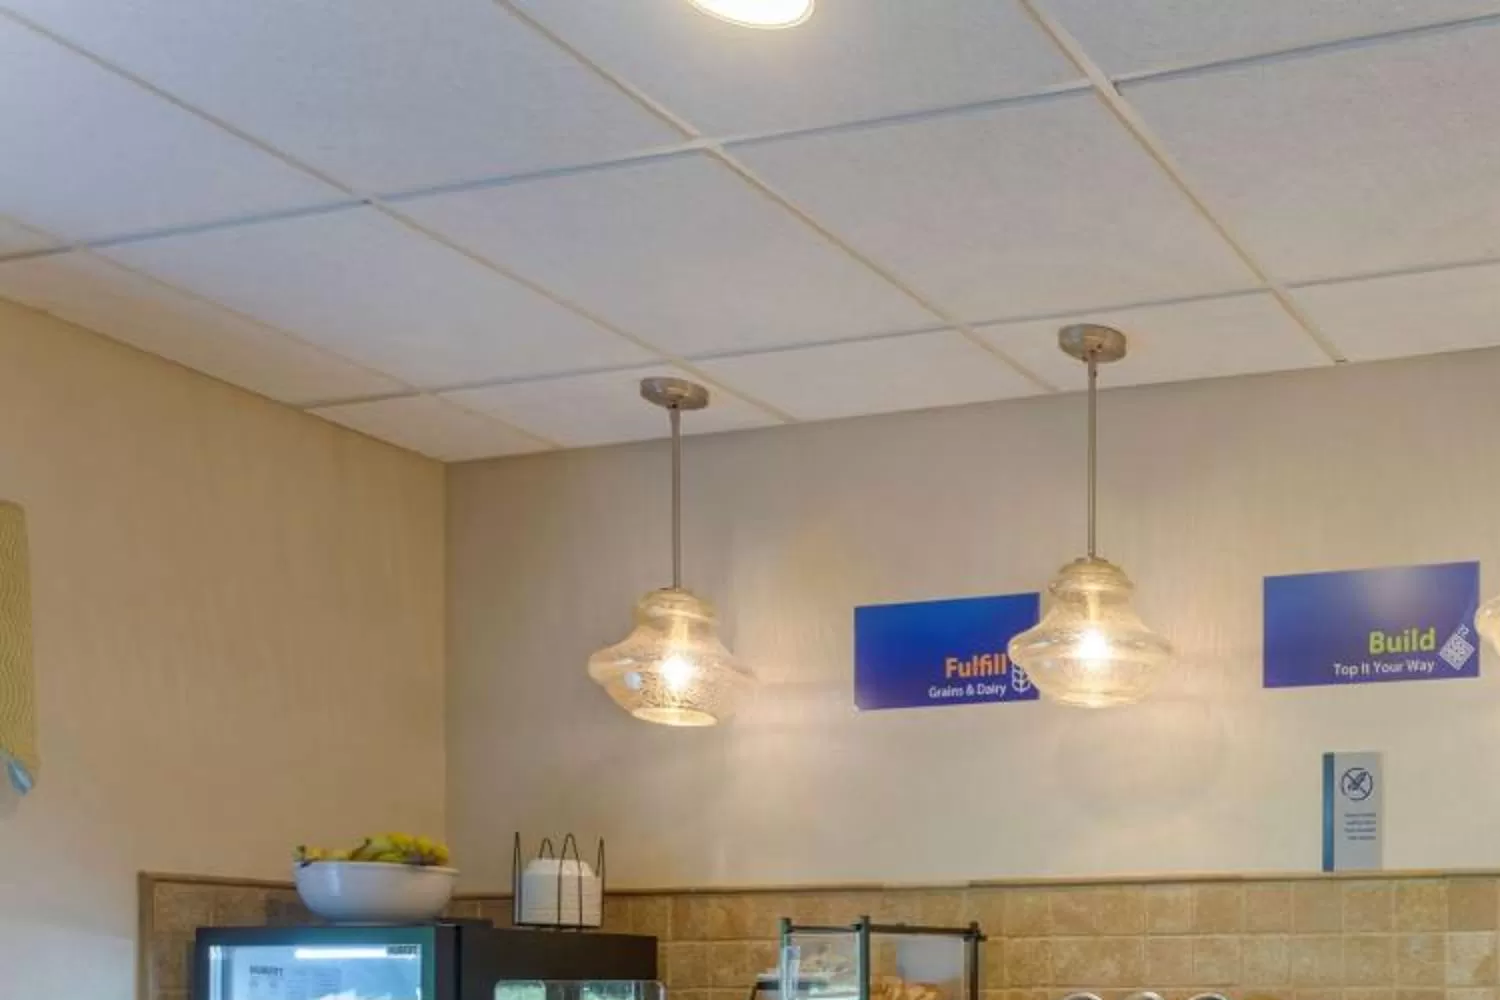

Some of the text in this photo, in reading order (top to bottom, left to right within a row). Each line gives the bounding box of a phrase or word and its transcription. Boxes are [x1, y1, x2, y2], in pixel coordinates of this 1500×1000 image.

[1368, 626, 1436, 655] Build
[945, 652, 1007, 679] Fulfill
[1333, 658, 1435, 678] Top It Your Way
[928, 682, 1007, 699] Grains & Dairy
